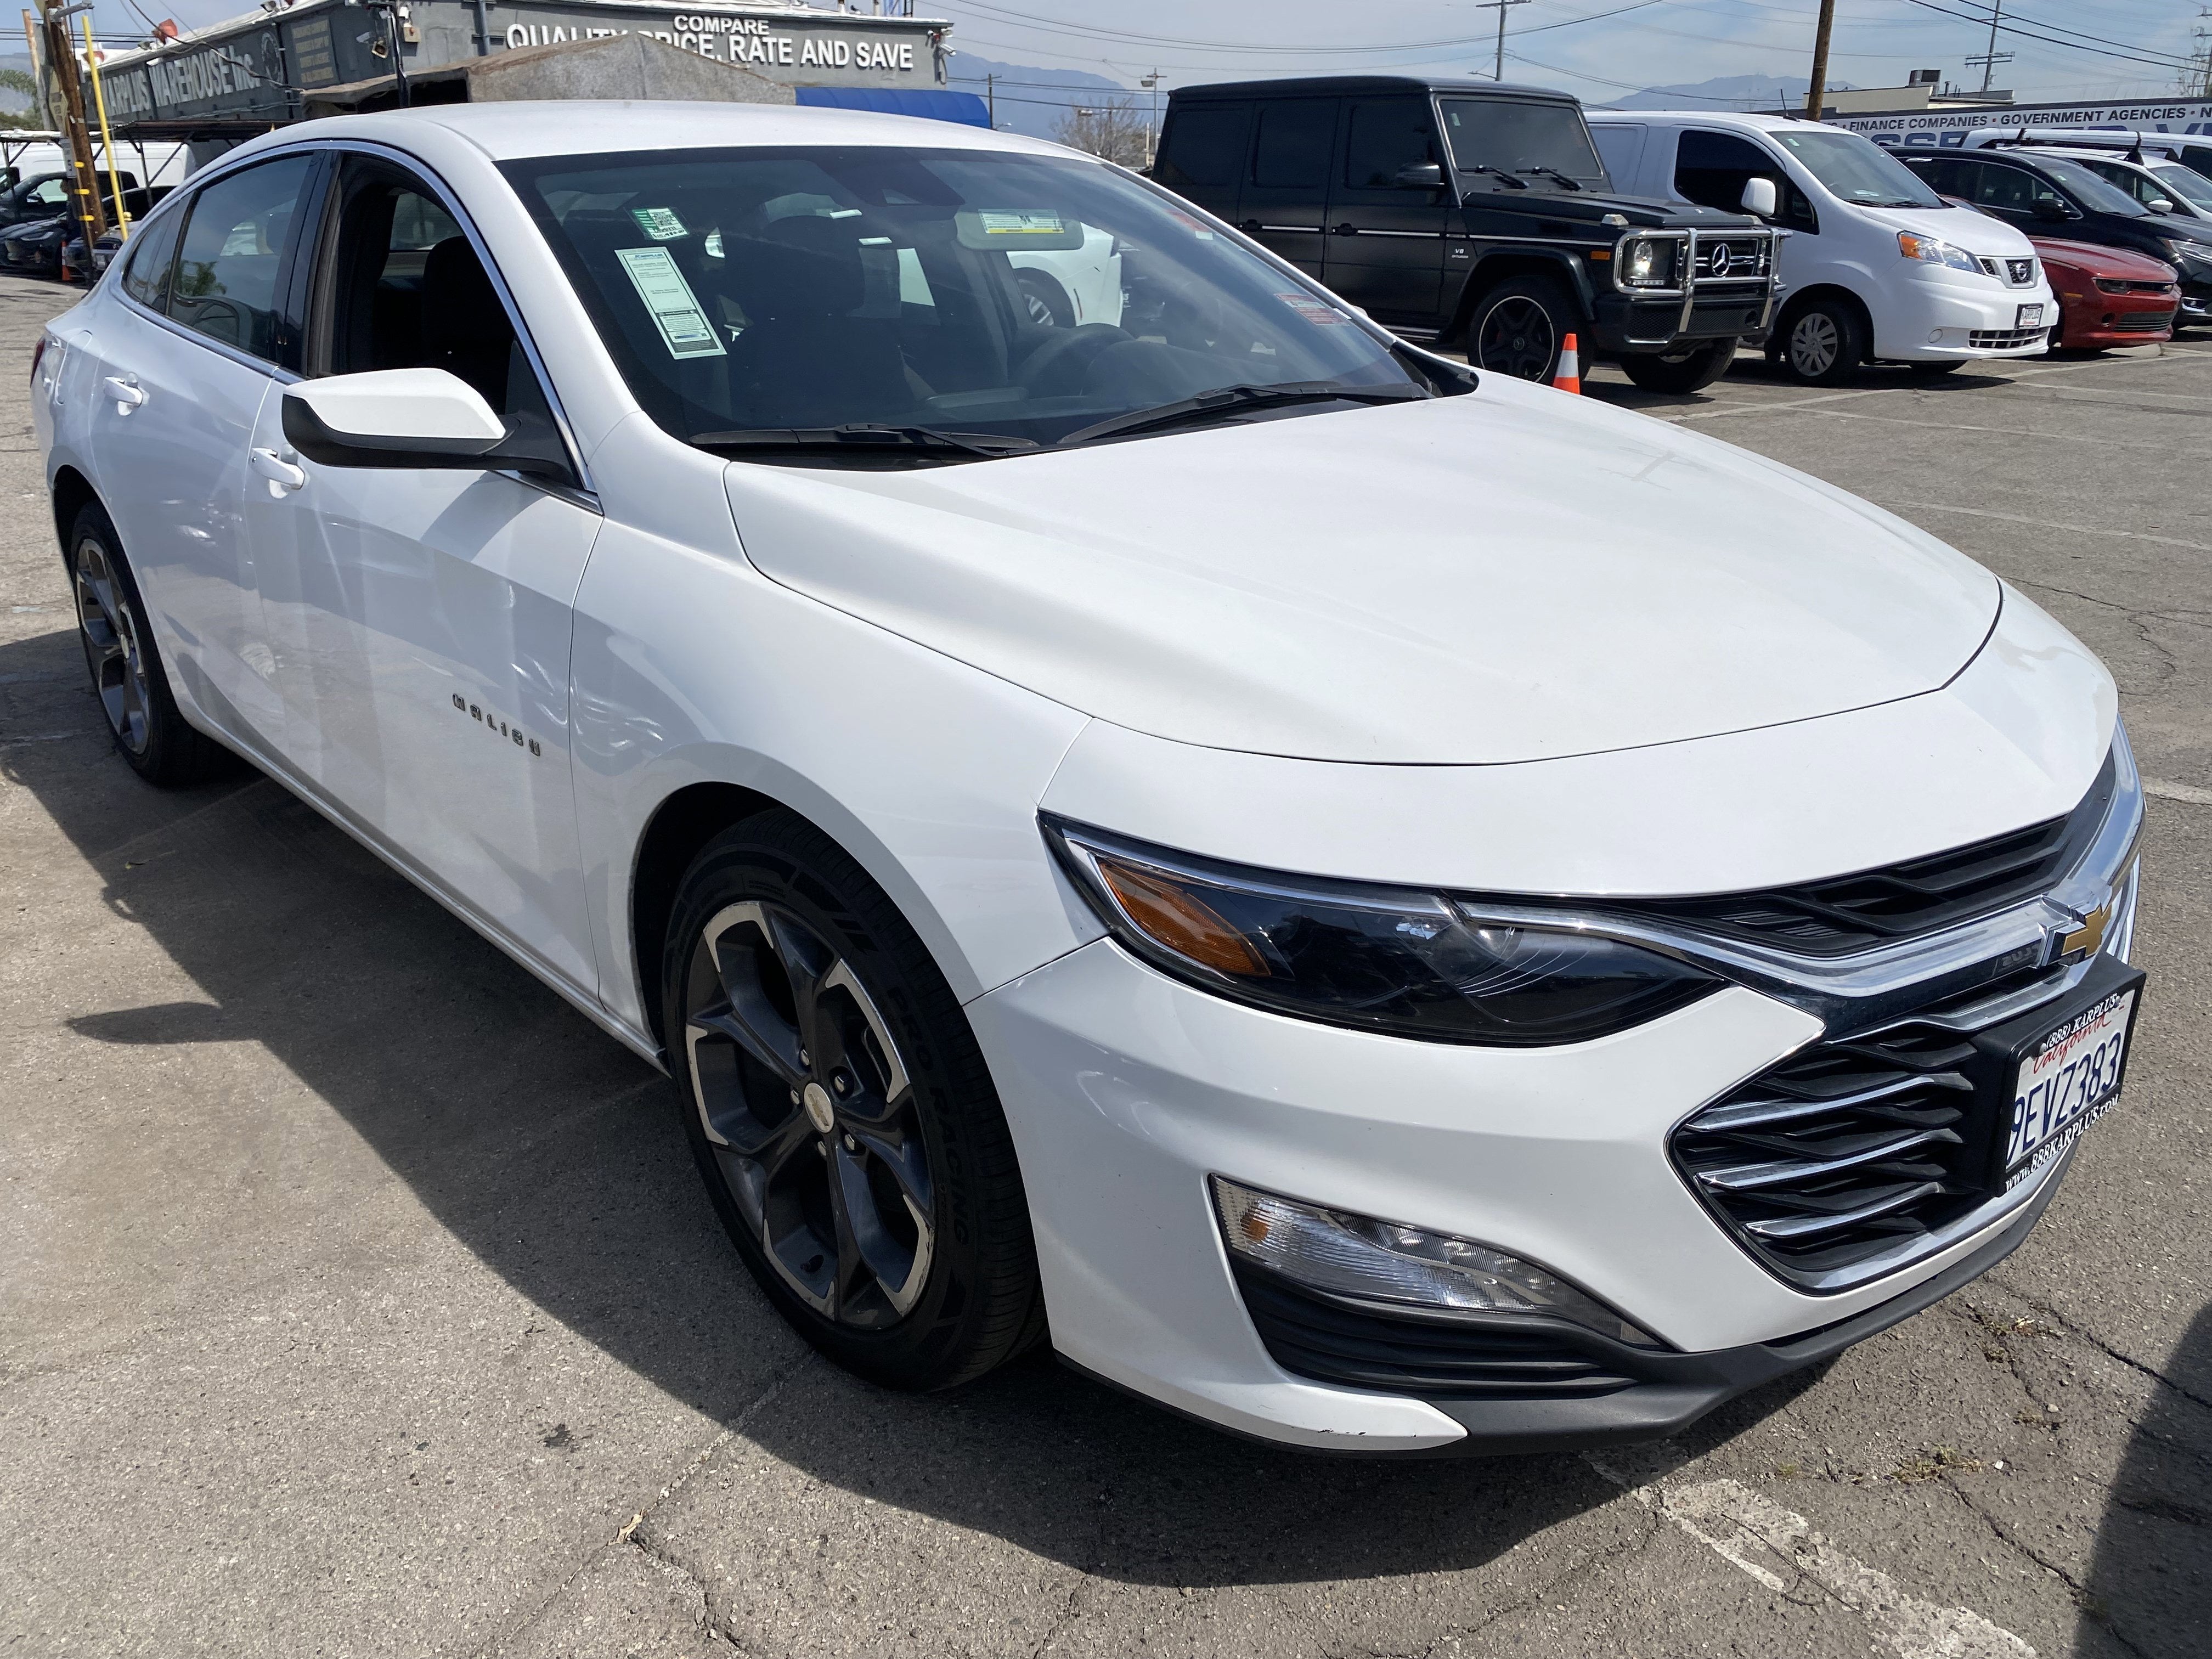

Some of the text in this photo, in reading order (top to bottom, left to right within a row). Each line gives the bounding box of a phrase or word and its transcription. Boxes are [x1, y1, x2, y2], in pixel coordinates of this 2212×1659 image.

[506, 24, 913, 69] QUAL ICE, RATE AND SAVE
[674, 15, 769, 35] COMPARE
[148, 47, 234, 107] WAREHOUSE
[1849, 119, 1905, 131] FINANCE
[1909, 115, 1988, 129] COMPANIES
[2001, 110, 2104, 125] GOVERNMENT
[2108, 107, 2186, 121] AGENCIES
[452, 693, 540, 757] MALIBU
[2046, 992, 2118, 1049] (888) KARPLUS
[887, 986, 970, 1246] PRO RACING
[2006, 1032, 2121, 1166] 9EVZ383
